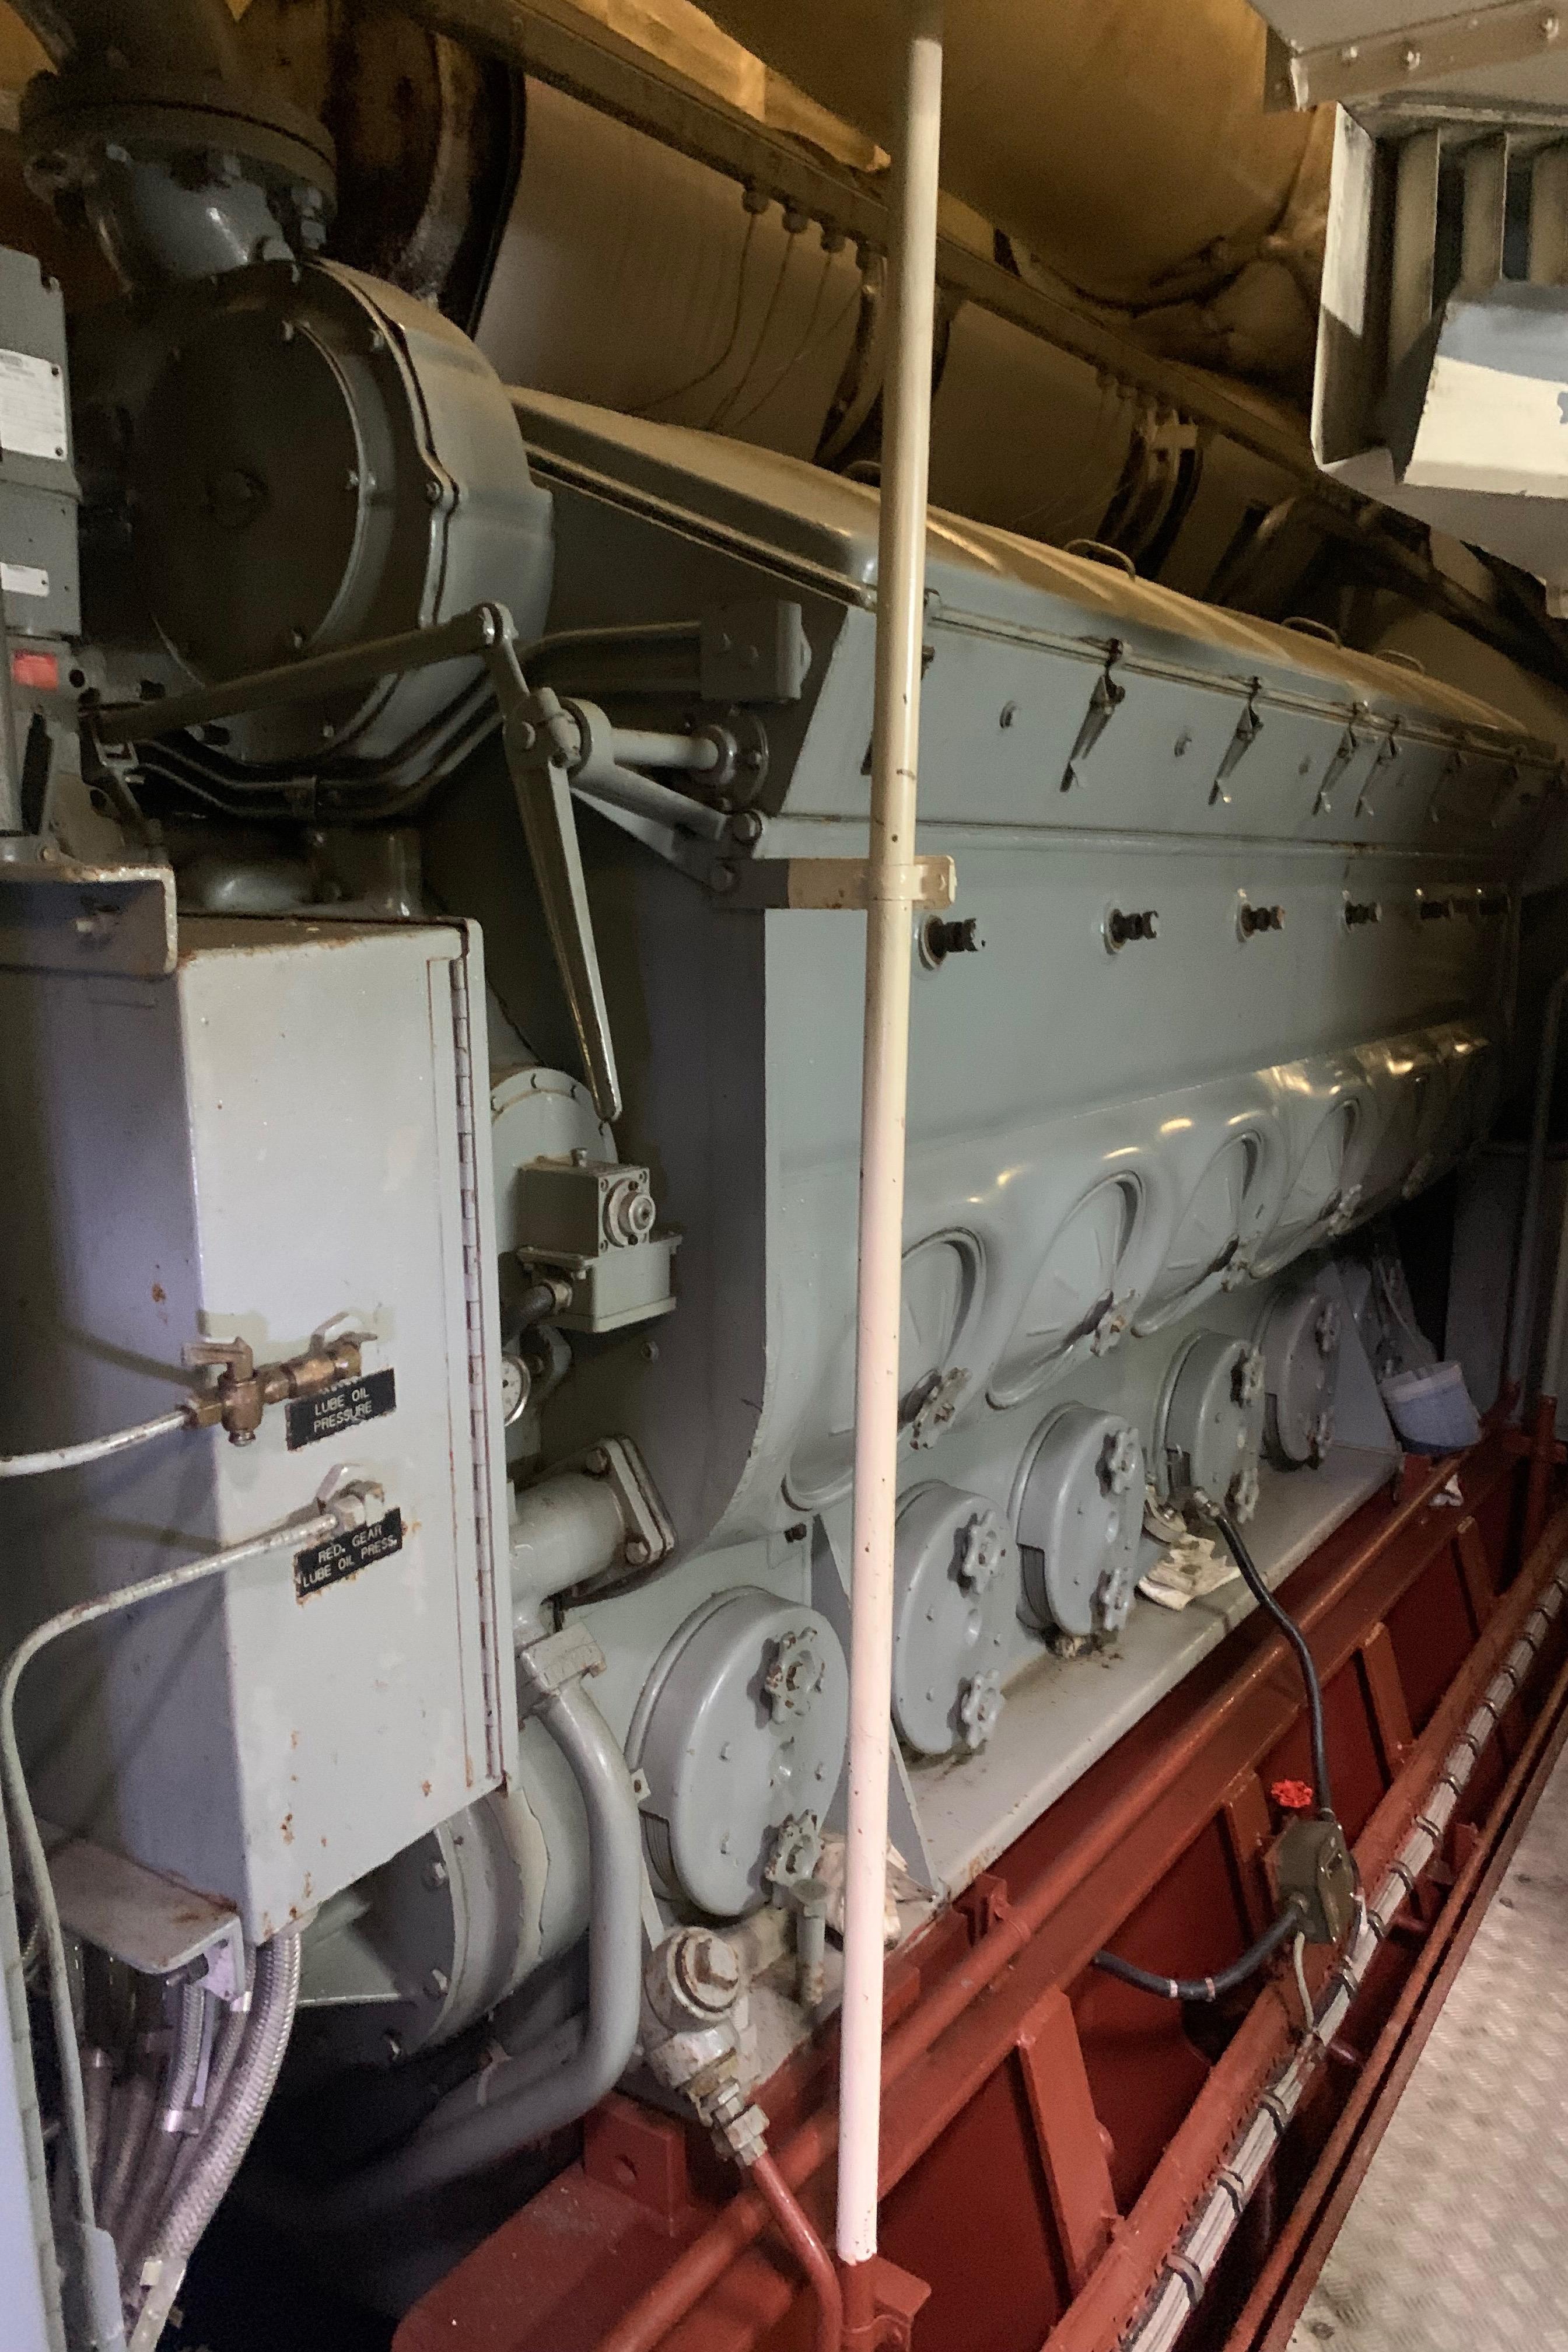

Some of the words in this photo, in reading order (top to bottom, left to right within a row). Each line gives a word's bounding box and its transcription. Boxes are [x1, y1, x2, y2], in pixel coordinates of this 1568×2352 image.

[314, 1400, 373, 1433] PRESSURE
[315, 1394, 345, 1416] LUBE
[352, 1387, 370, 1402] OIL
[318, 1544, 346, 1563] RED.
[352, 1523, 382, 1546] GEAR
[303, 1564, 332, 1588] LUBE
[338, 1555, 355, 1570] OIL
[360, 1535, 398, 1560] PRESS.
